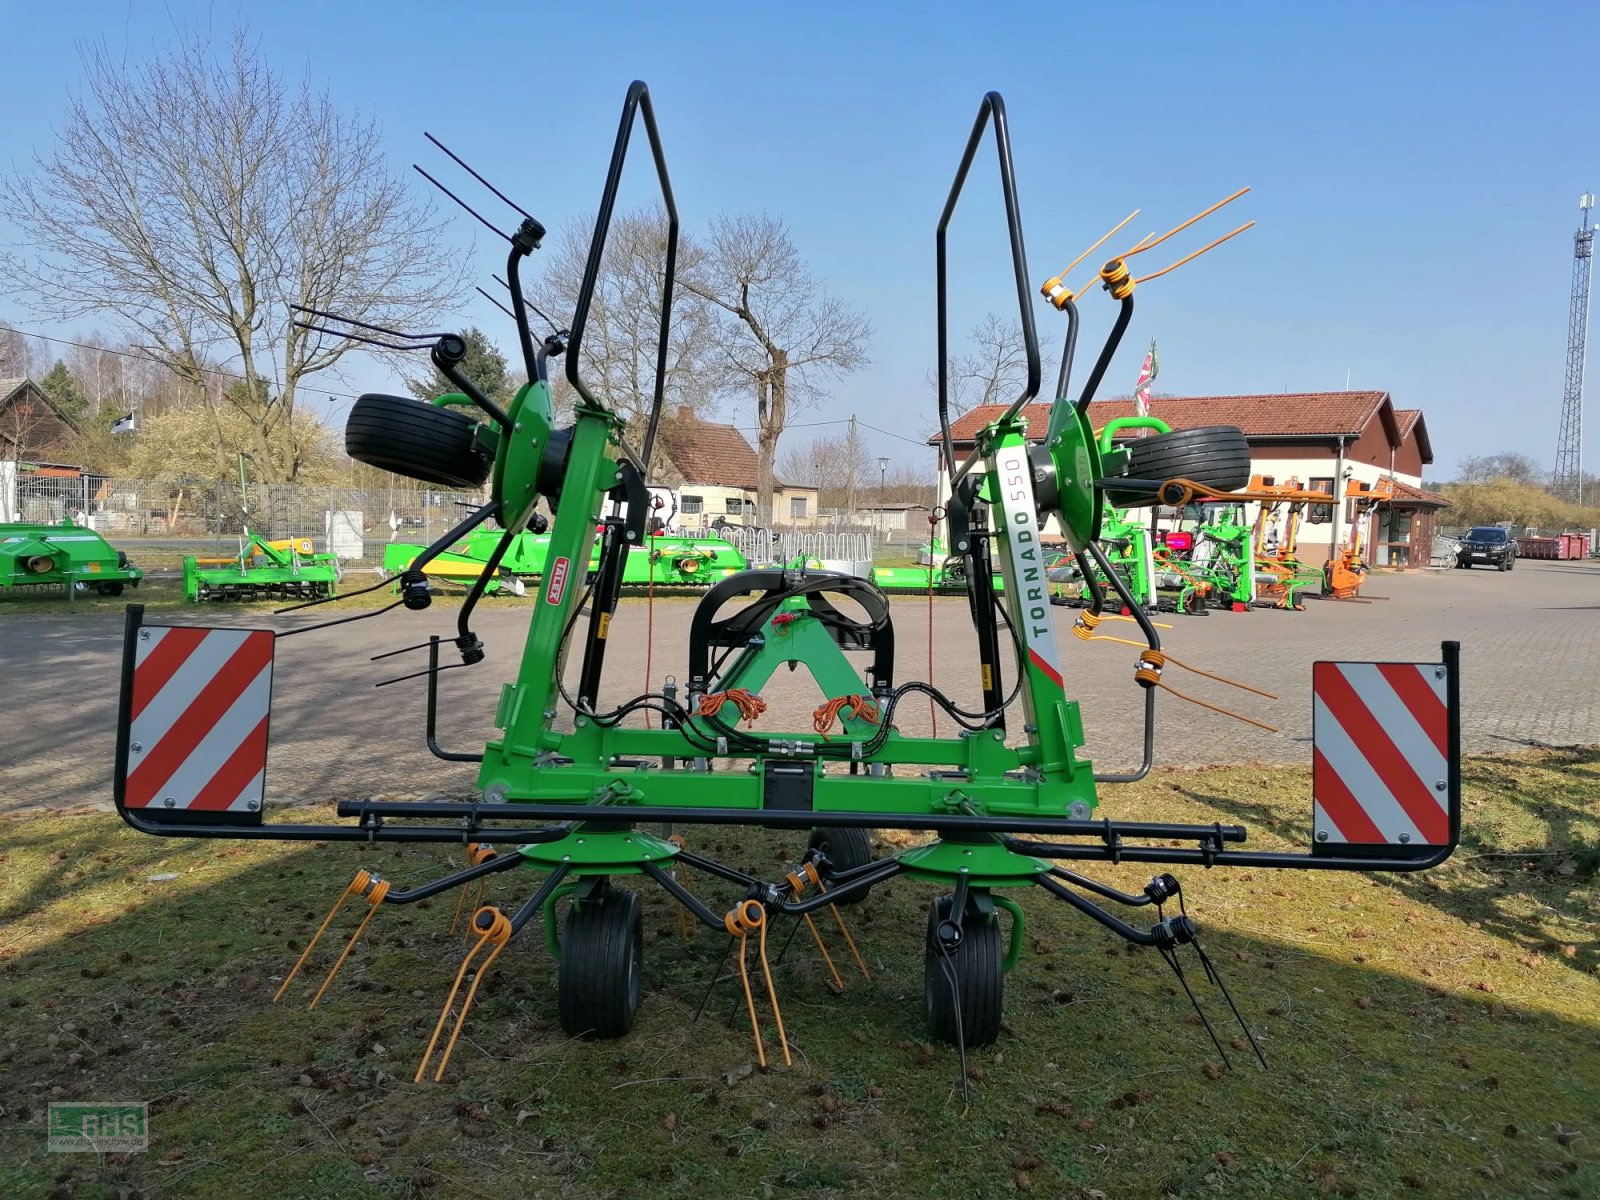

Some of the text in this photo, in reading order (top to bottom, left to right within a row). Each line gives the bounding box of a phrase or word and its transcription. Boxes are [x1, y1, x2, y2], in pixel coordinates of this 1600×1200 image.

[549, 561, 567, 601] TALEX
[1005, 459, 1048, 638] TORNADO 550
